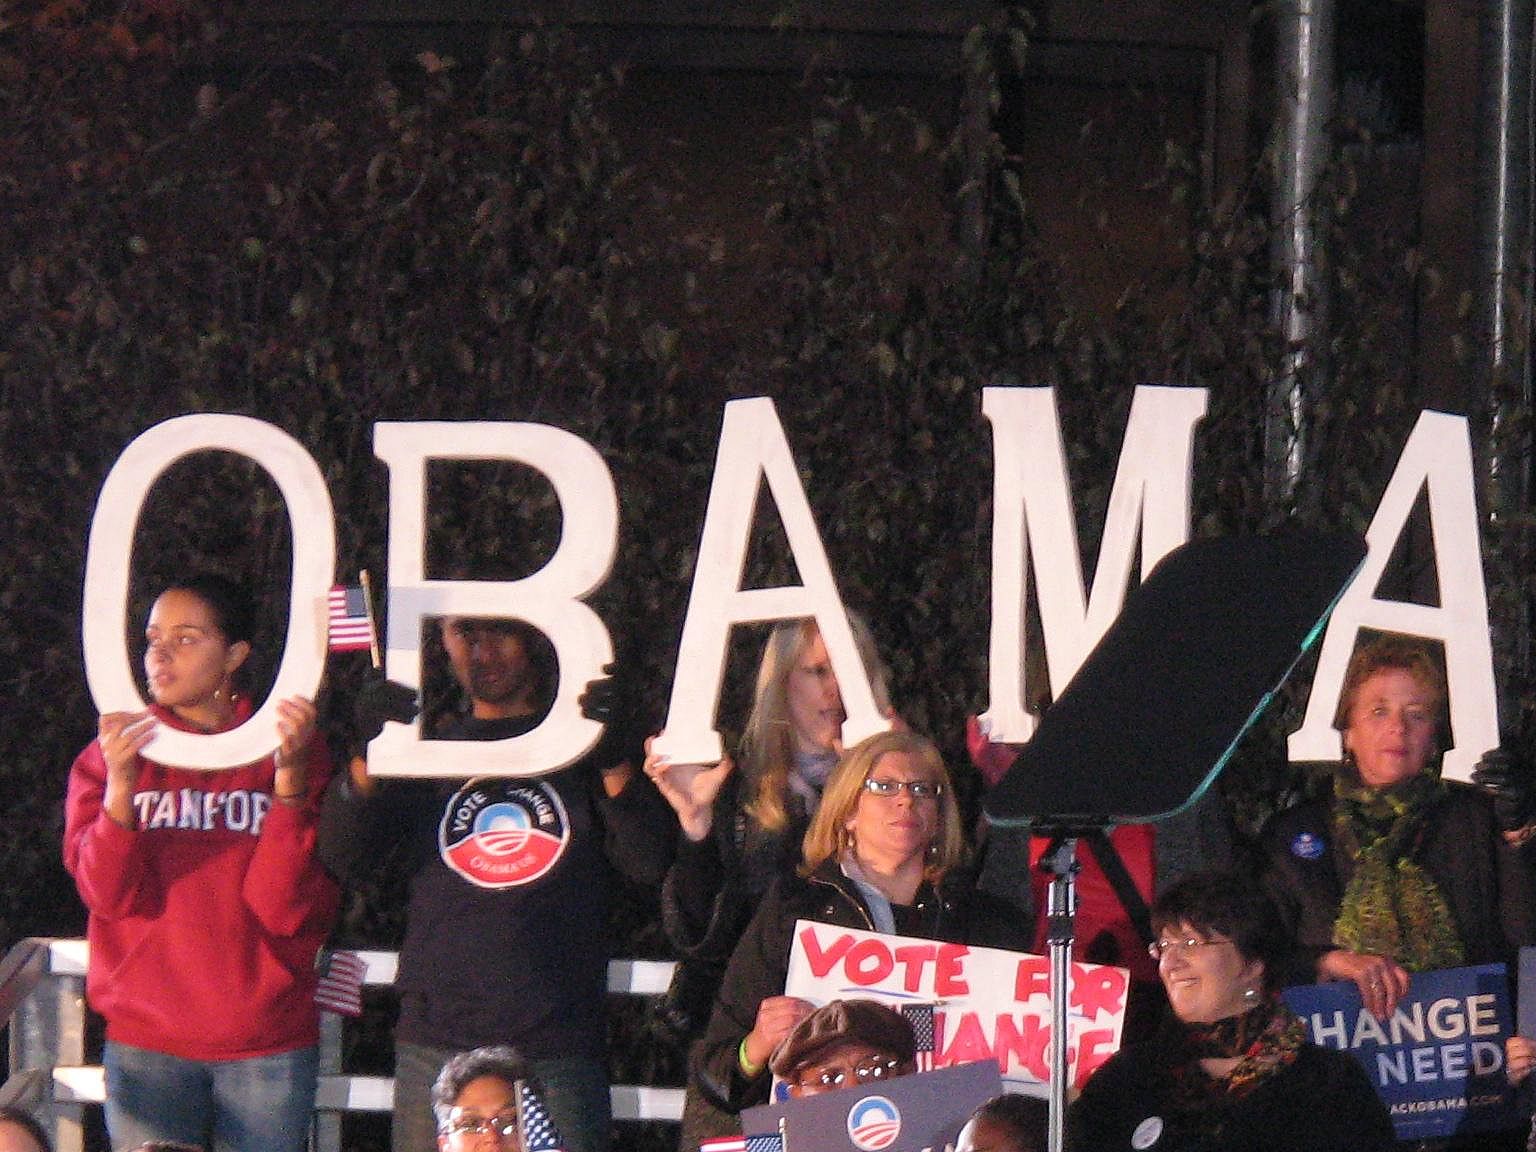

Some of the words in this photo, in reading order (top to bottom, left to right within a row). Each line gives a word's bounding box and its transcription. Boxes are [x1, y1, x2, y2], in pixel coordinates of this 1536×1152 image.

[452, 790, 488, 832] VOTE
[799, 926, 971, 997] VOTE
[1299, 993, 1501, 1050] HANGE
[1376, 1041, 1503, 1087] NEED
